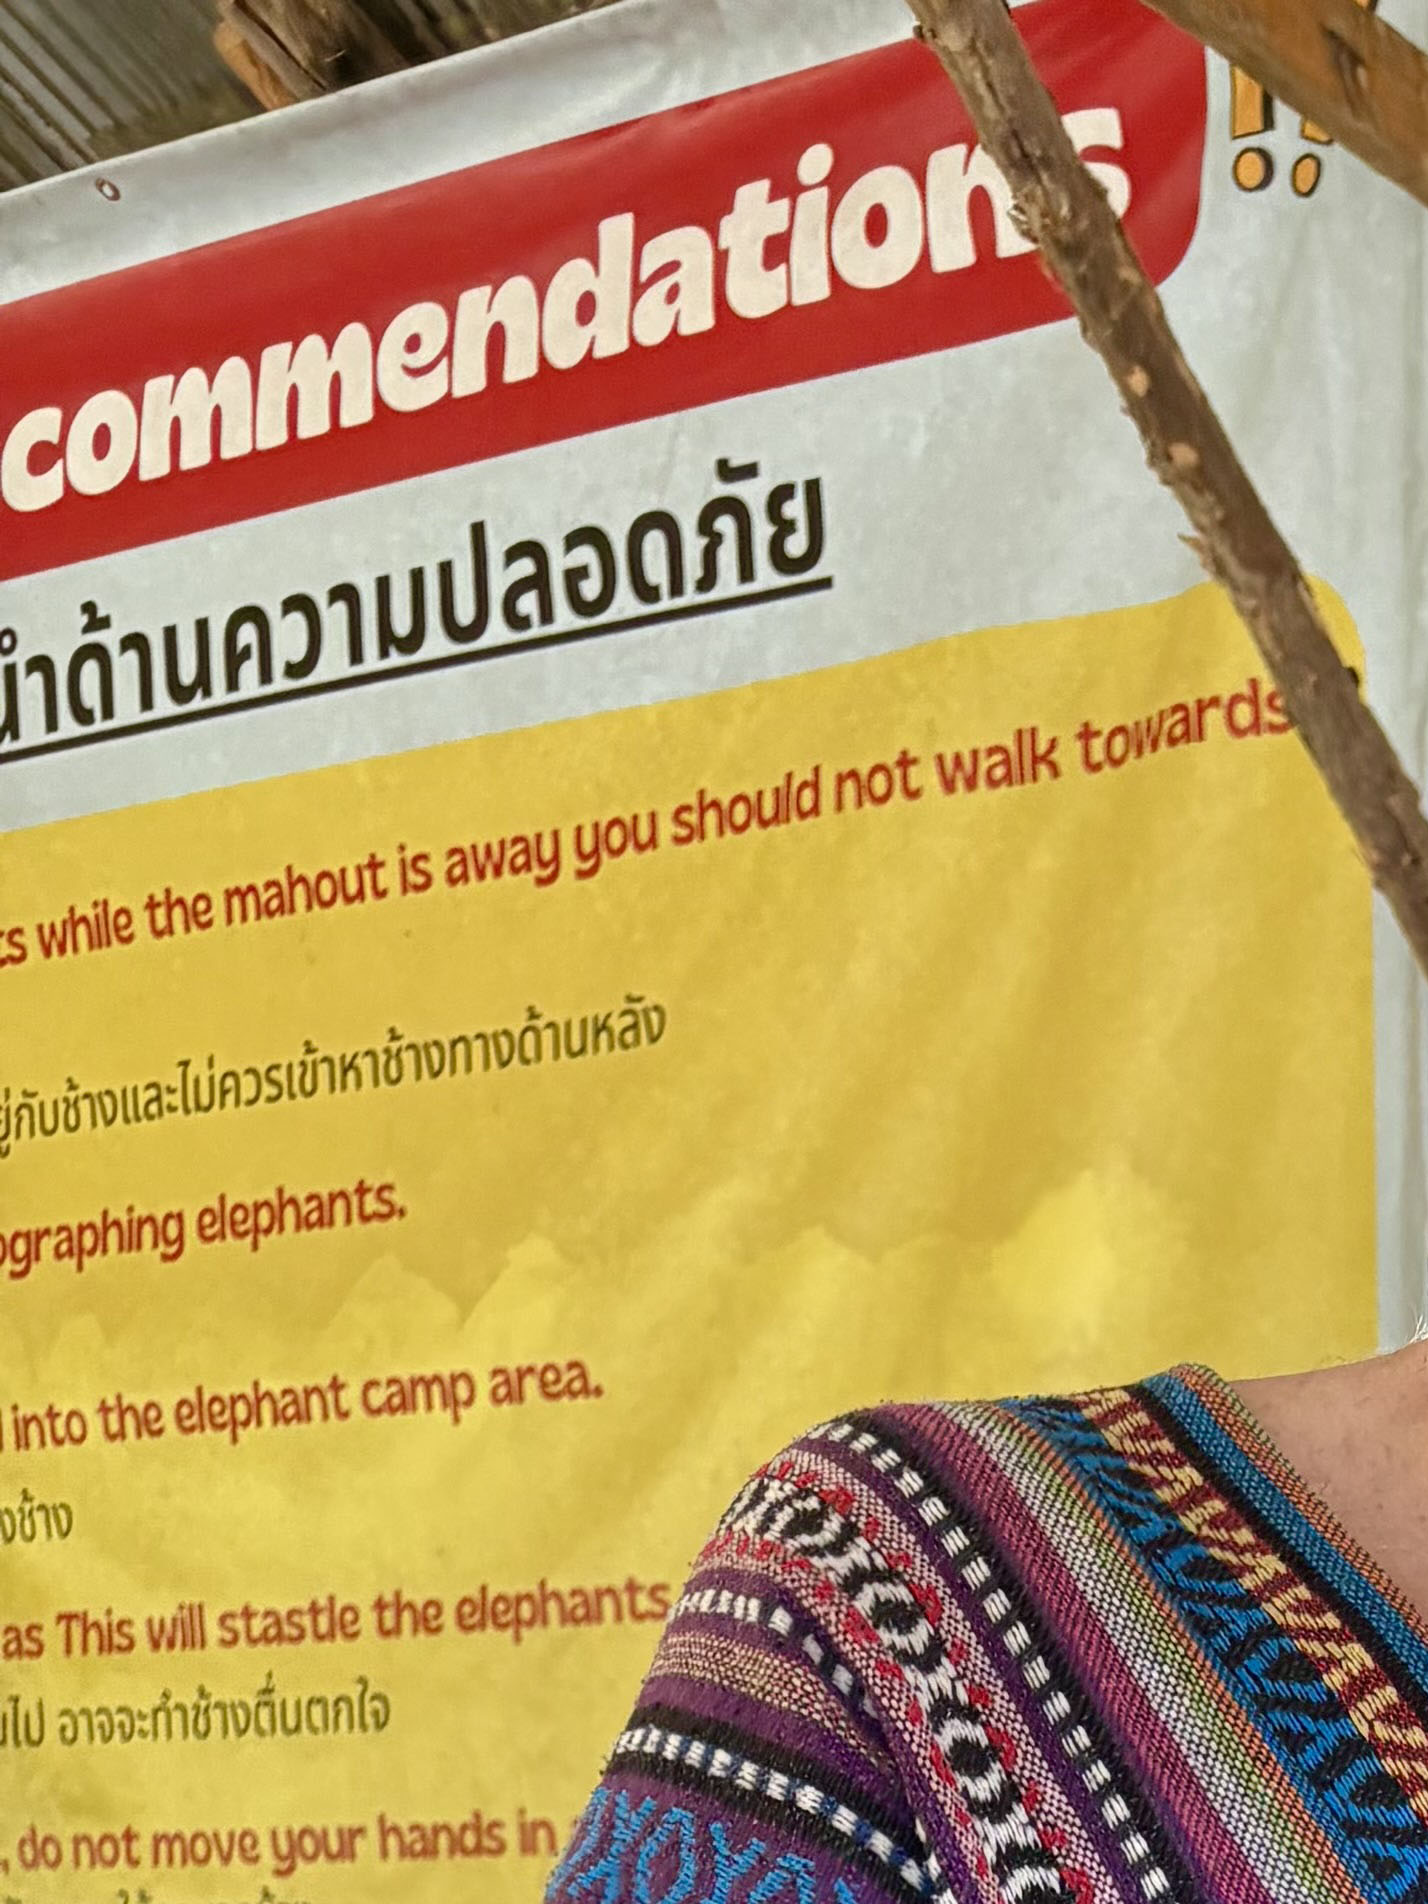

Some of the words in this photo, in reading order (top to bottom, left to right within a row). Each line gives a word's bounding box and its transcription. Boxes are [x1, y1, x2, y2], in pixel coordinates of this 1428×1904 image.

[36, 897, 135, 961] while
[144, 886, 214, 941] the
[223, 848, 389, 927] mahout
[398, 843, 435, 897] is
[444, 823, 561, 888] away
[573, 809, 659, 881] you
[671, 766, 822, 848] should
[832, 748, 923, 813] not
[934, 727, 1062, 795] walk
[1076, 677, 1296, 777] towards
[196, 1177, 408, 1252] elephants.
[11, 1404, 88, 1452] into
[97, 1392, 165, 1443] the
[174, 1373, 350, 1445] elephant
[360, 1369, 475, 1426] camp
[488, 1358, 605, 1408] area.
[2, 1622, 44, 1660] as
[55, 1607, 136, 1658] This
[146, 1600, 207, 1653] will
[217, 1594, 360, 1650] stastle
[371, 1588, 444, 1640] the
[454, 1576, 672, 1645] elephants
[17, 1823, 62, 1872] do
[71, 1824, 141, 1870] not
[151, 1826, 260, 1869] move
[270, 1820, 366, 1880] your
[378, 1809, 505, 1862] hands
[516, 1806, 557, 1857] in
